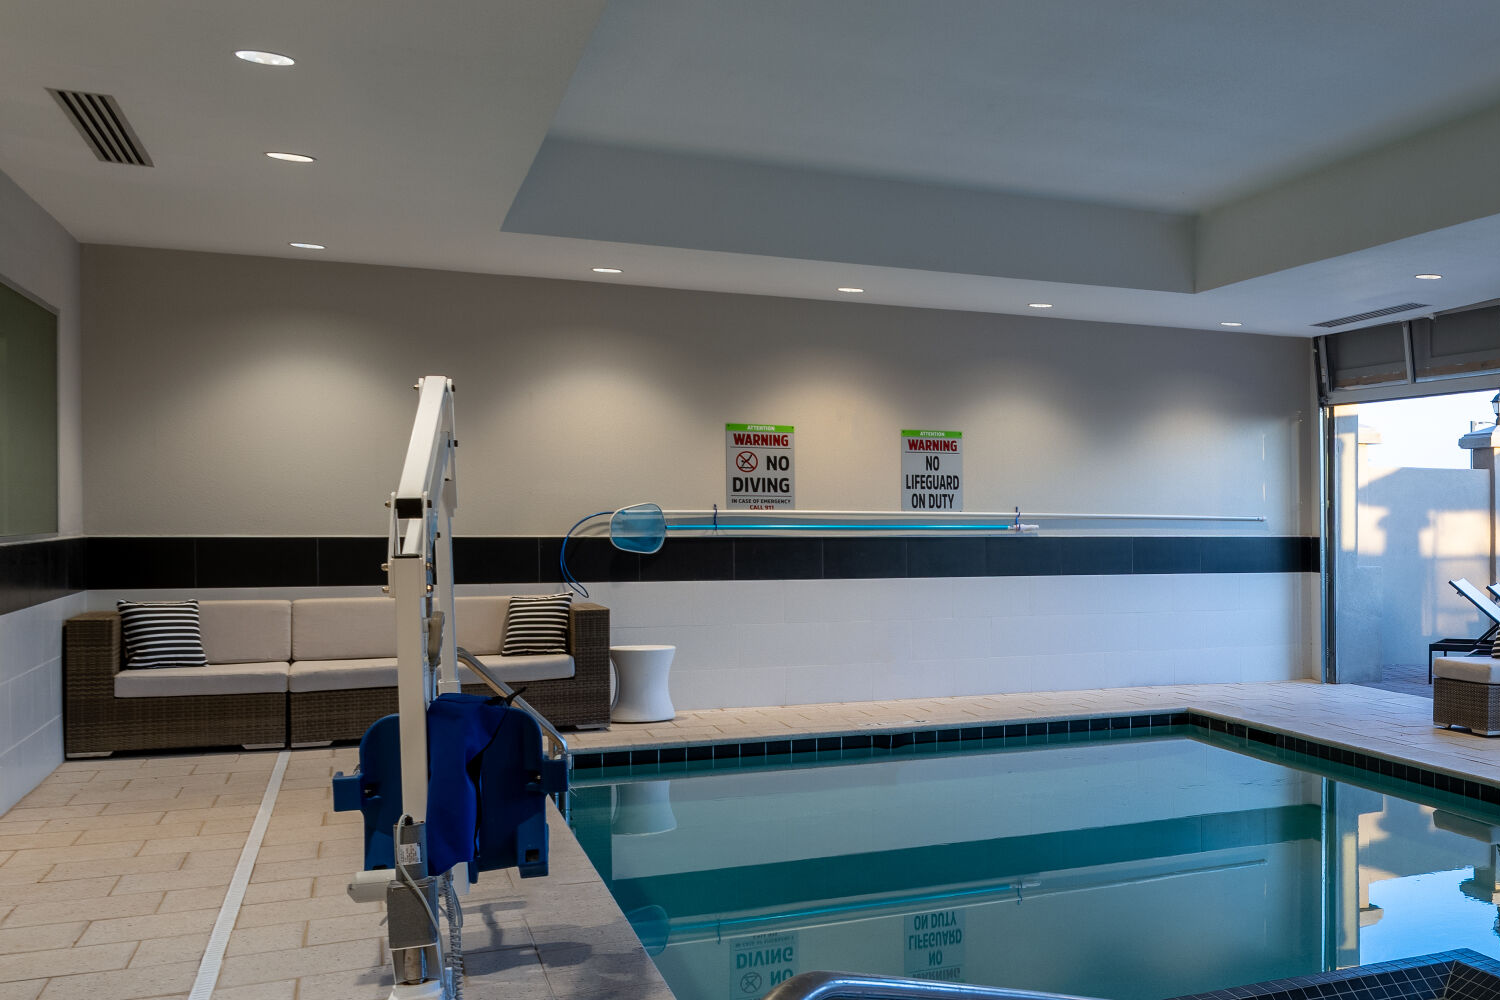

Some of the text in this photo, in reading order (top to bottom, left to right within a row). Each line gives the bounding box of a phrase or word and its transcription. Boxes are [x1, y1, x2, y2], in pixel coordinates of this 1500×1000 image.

[733, 433, 789, 447] WARNING
[907, 439, 958, 452] WARNING
[766, 455, 790, 471] NO
[925, 455, 940, 471] NO
[732, 477, 790, 493] DIVING
[905, 474, 960, 490] LIFEGUARD
[911, 493, 954, 509] ON DUTY
